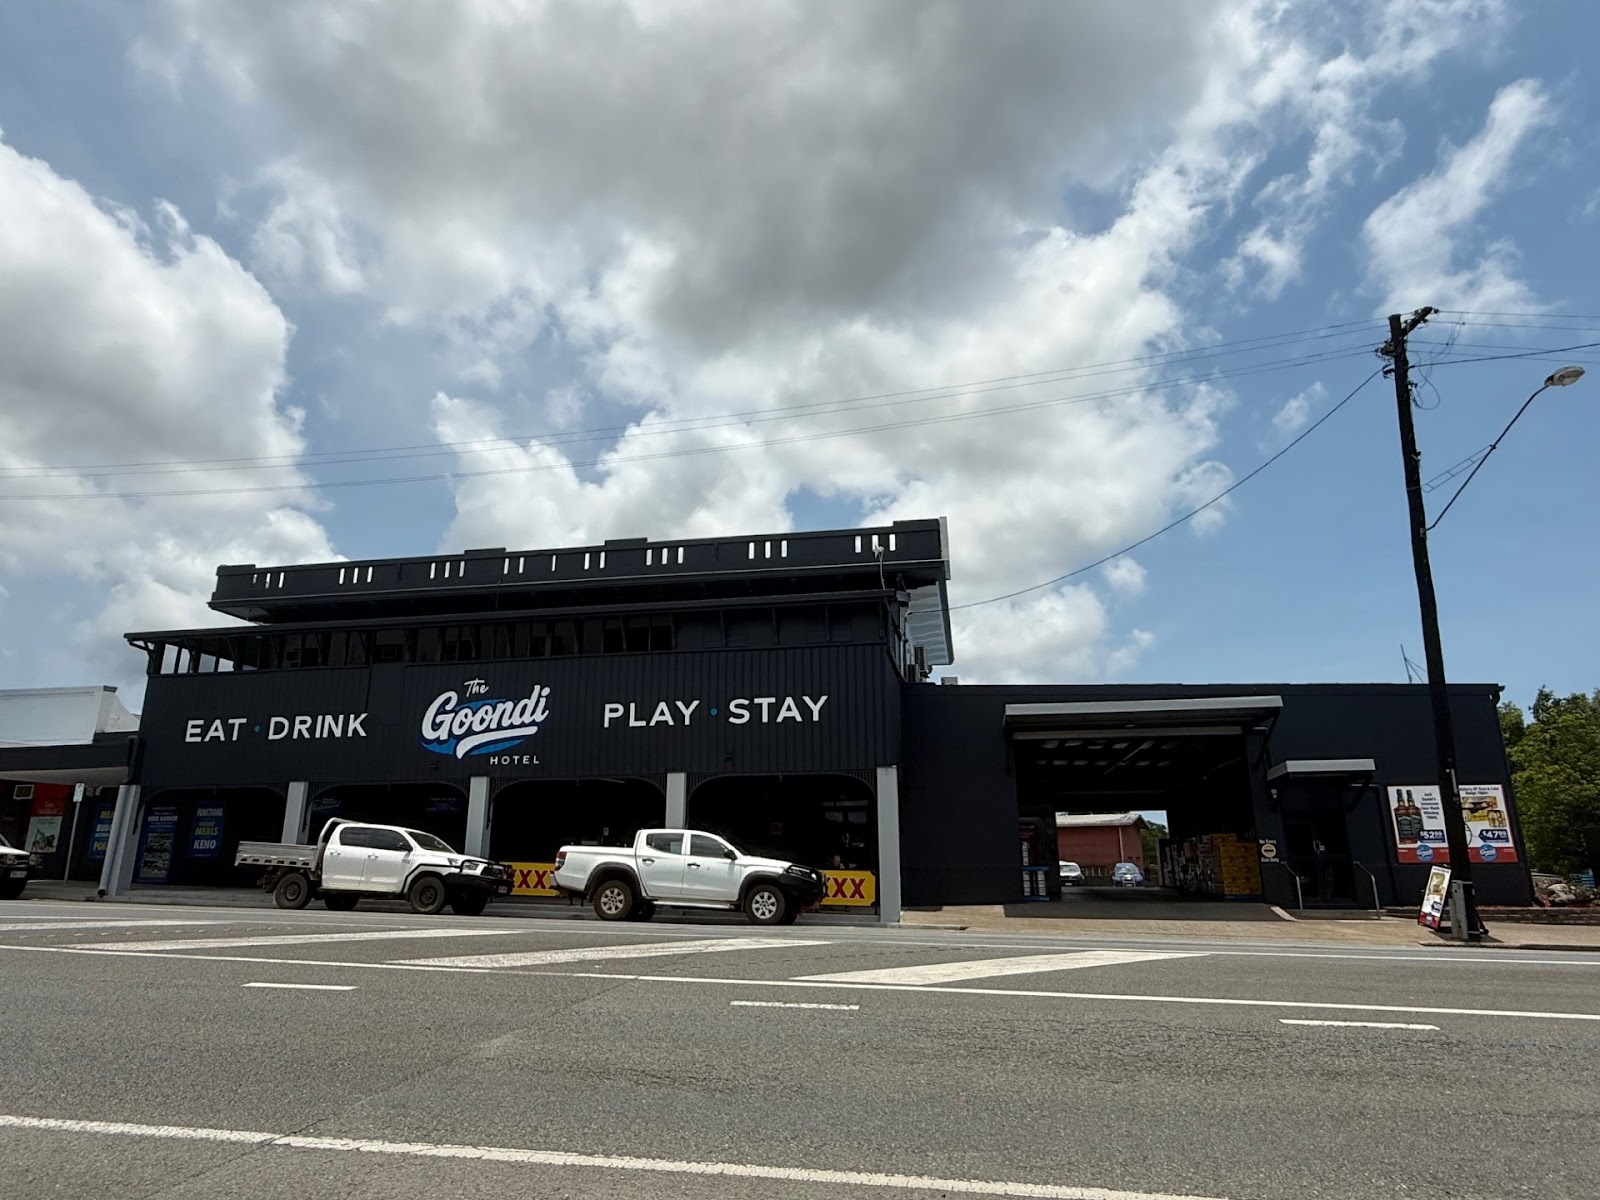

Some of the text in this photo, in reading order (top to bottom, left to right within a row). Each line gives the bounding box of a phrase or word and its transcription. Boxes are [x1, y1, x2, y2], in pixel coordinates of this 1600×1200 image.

[464, 678, 490, 698] The
[422, 685, 551, 741] Goondi
[603, 695, 829, 728] PLAY STAY
[184, 713, 368, 743] EAT DRINK
[489, 755, 540, 765] HOTEL
[193, 839, 217, 849] KENO
